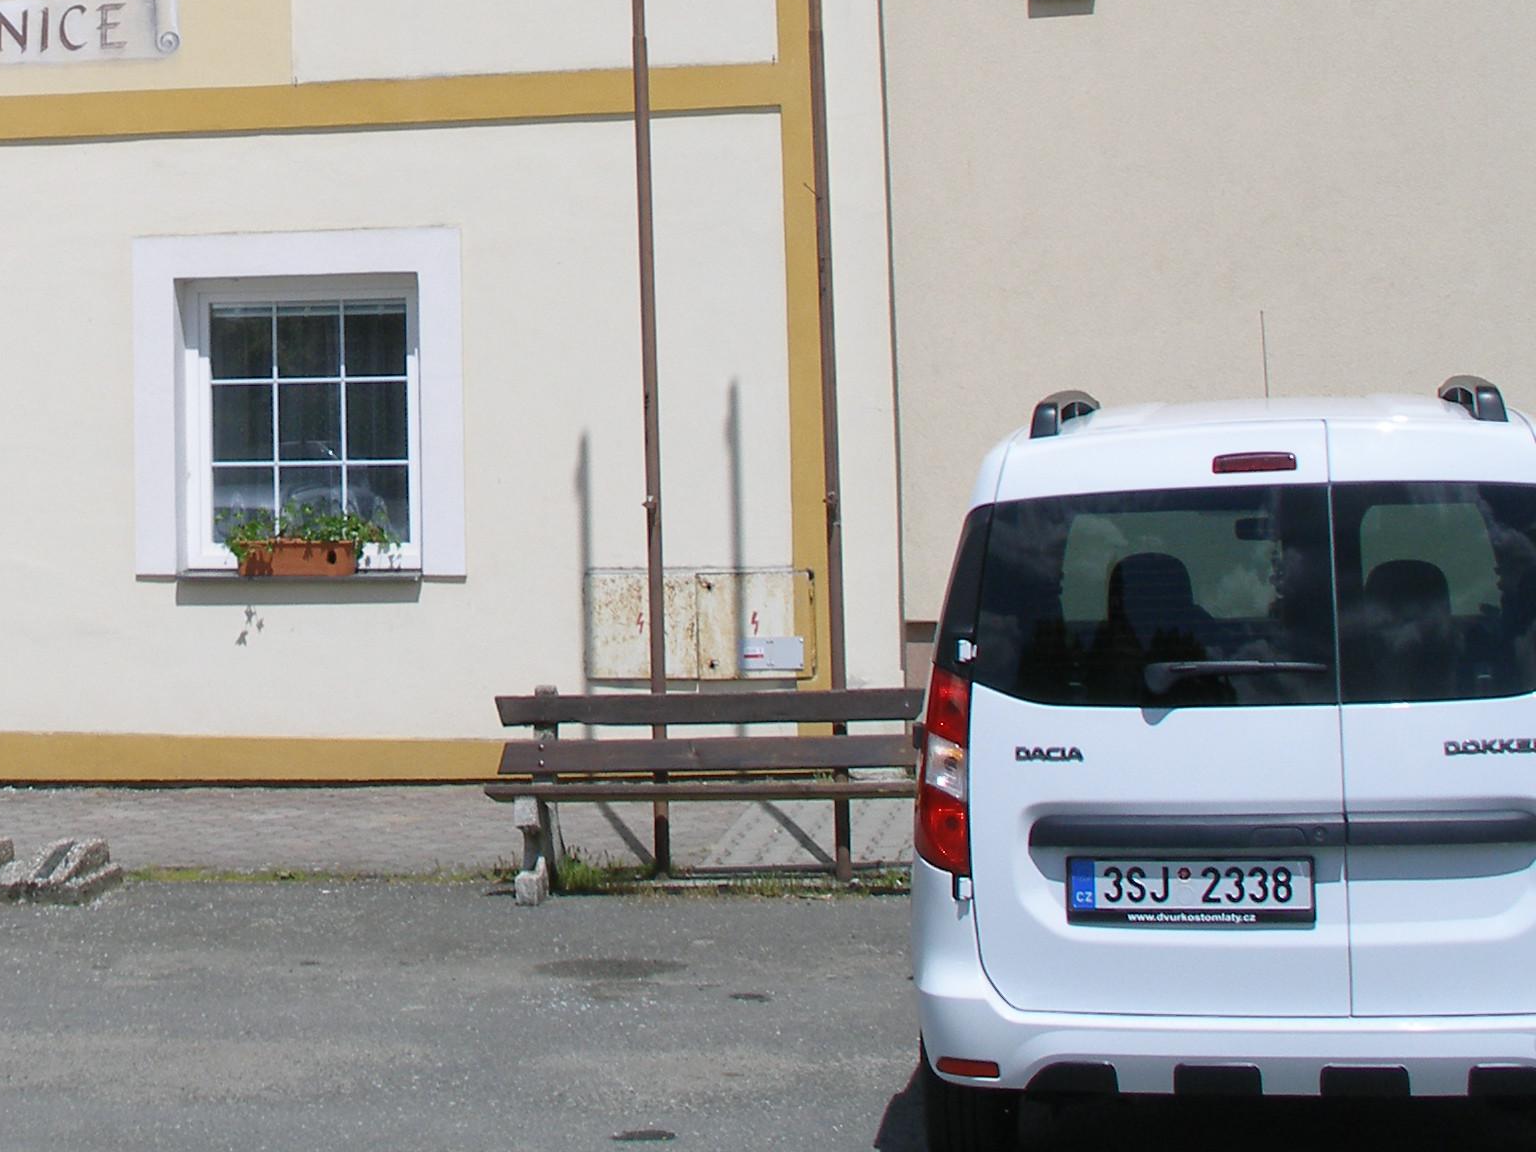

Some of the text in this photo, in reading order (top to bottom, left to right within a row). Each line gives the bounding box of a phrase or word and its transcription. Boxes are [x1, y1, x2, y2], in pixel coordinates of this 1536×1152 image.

[1015, 746, 1084, 762] DACIA
[1103, 866, 1293, 903] 3SJ 2338
[1076, 891, 1093, 902] CZ
[1127, 912, 1257, 924] www.dvurkostomlaty.cz
